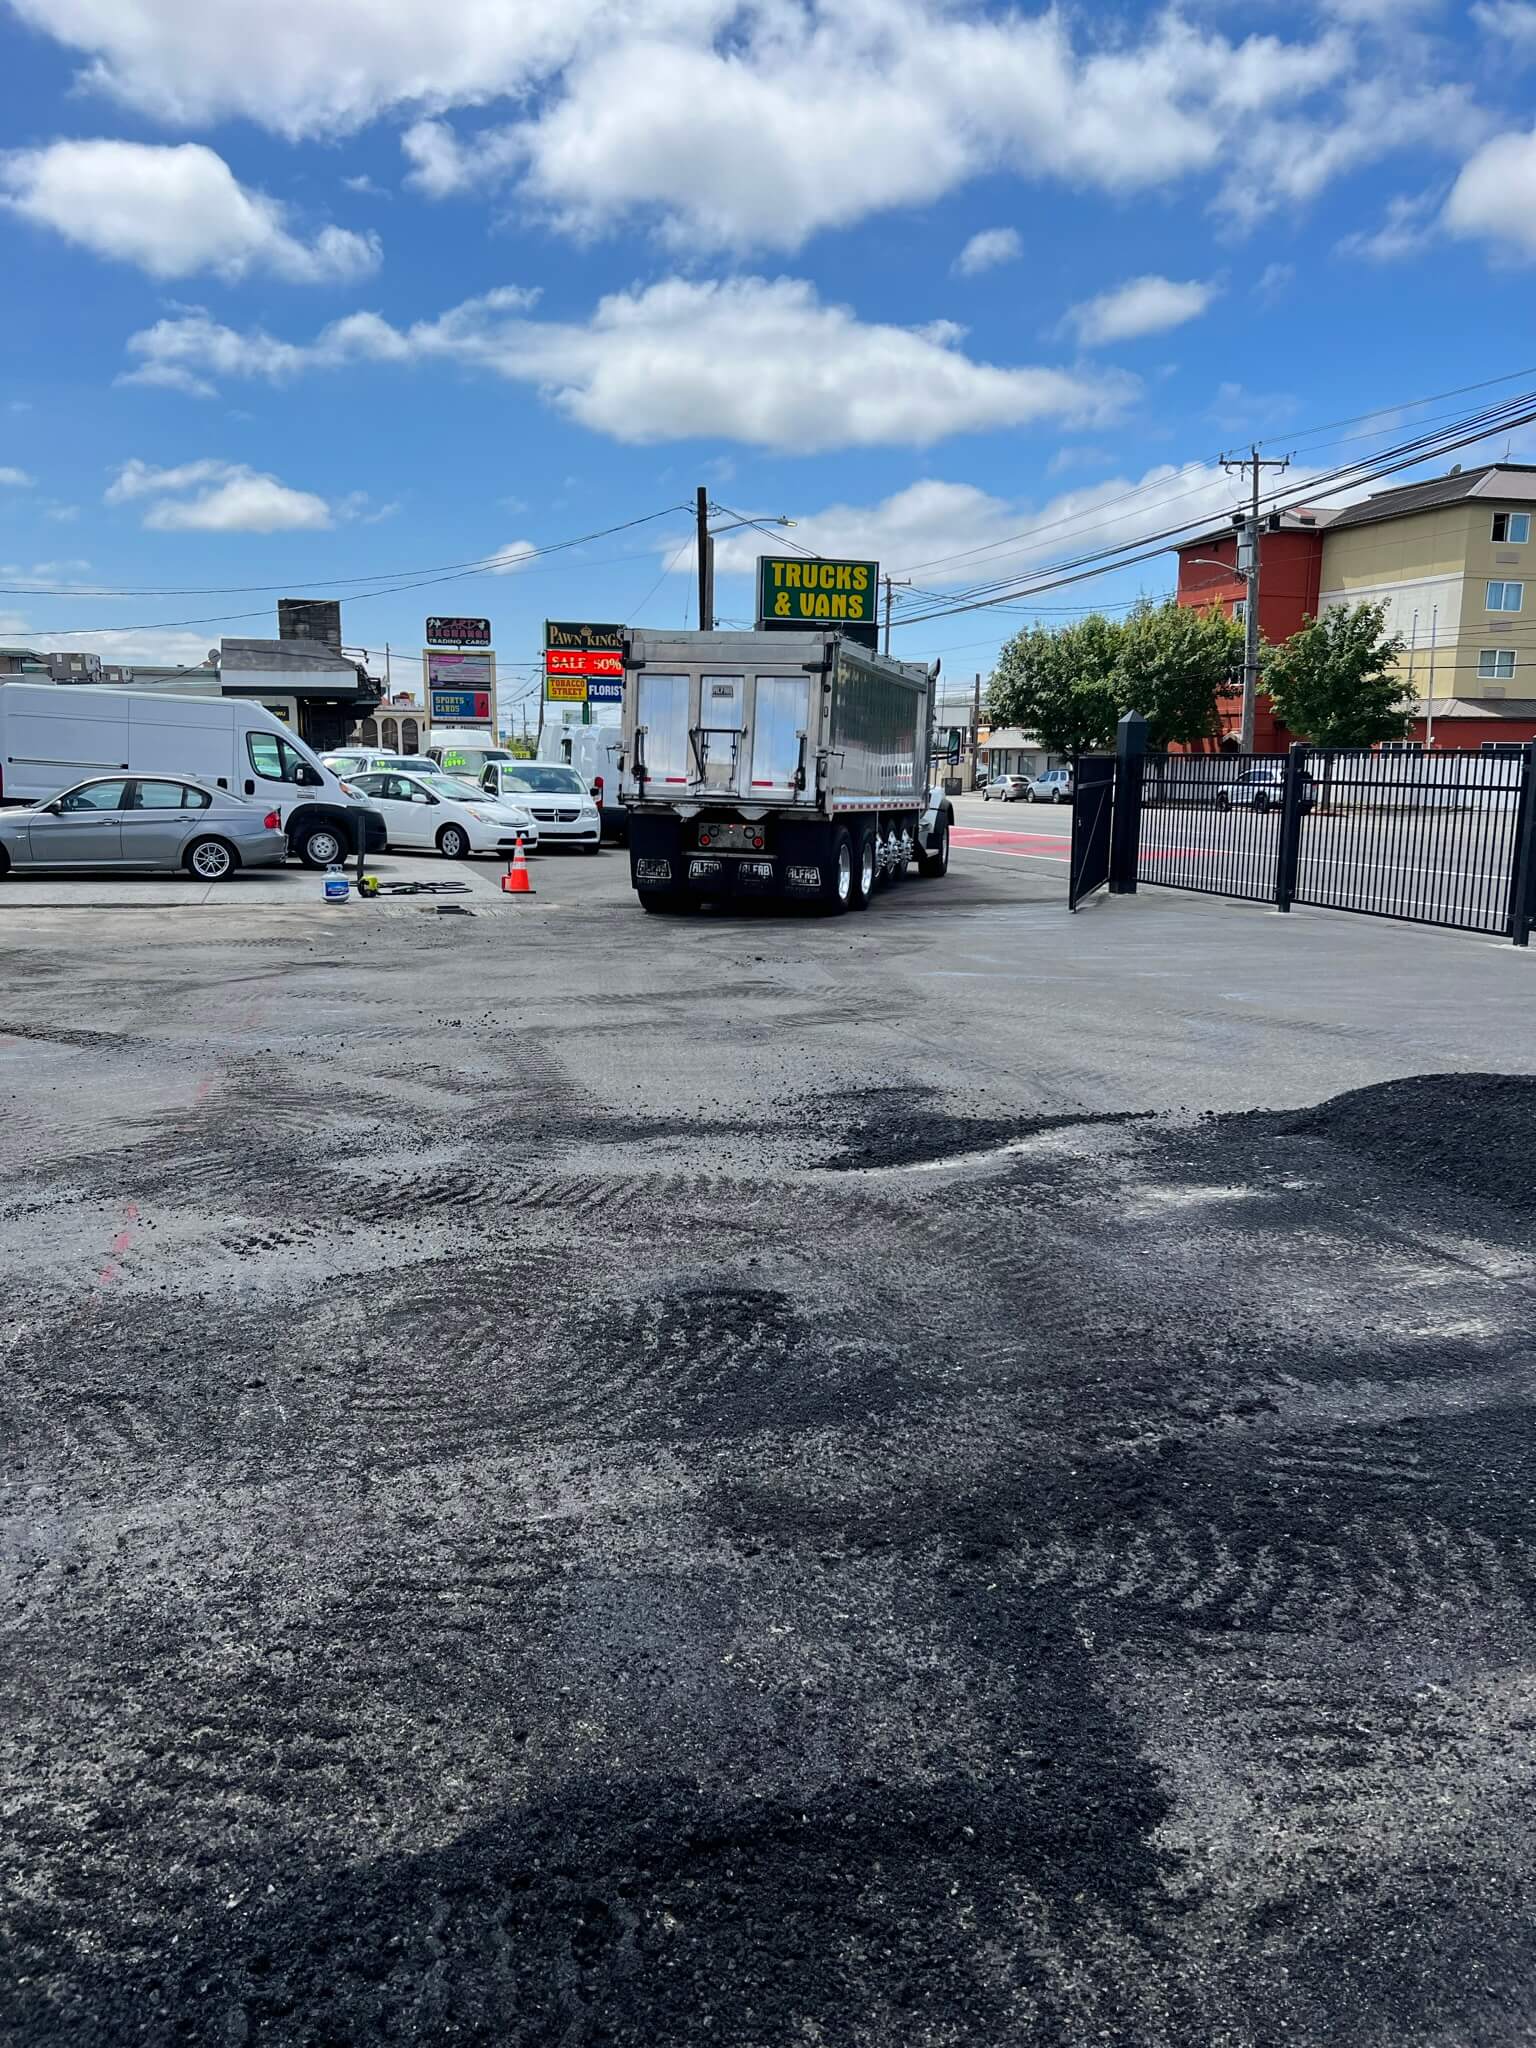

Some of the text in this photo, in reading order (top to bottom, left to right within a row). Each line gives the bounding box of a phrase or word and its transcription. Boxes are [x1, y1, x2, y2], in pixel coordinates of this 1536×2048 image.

[771, 562, 868, 591] TRUCKS
[774, 591, 864, 619] & VANS
[549, 625, 624, 647] PAWN KINGS
[551, 656, 622, 671] SALE 50%
[550, 679, 585, 688] TOBACCO
[551, 687, 583, 696] STREET
[435, 696, 465, 705] SPORTS
[435, 704, 460, 713] CARDS
[788, 867, 818, 880] ALFAB
